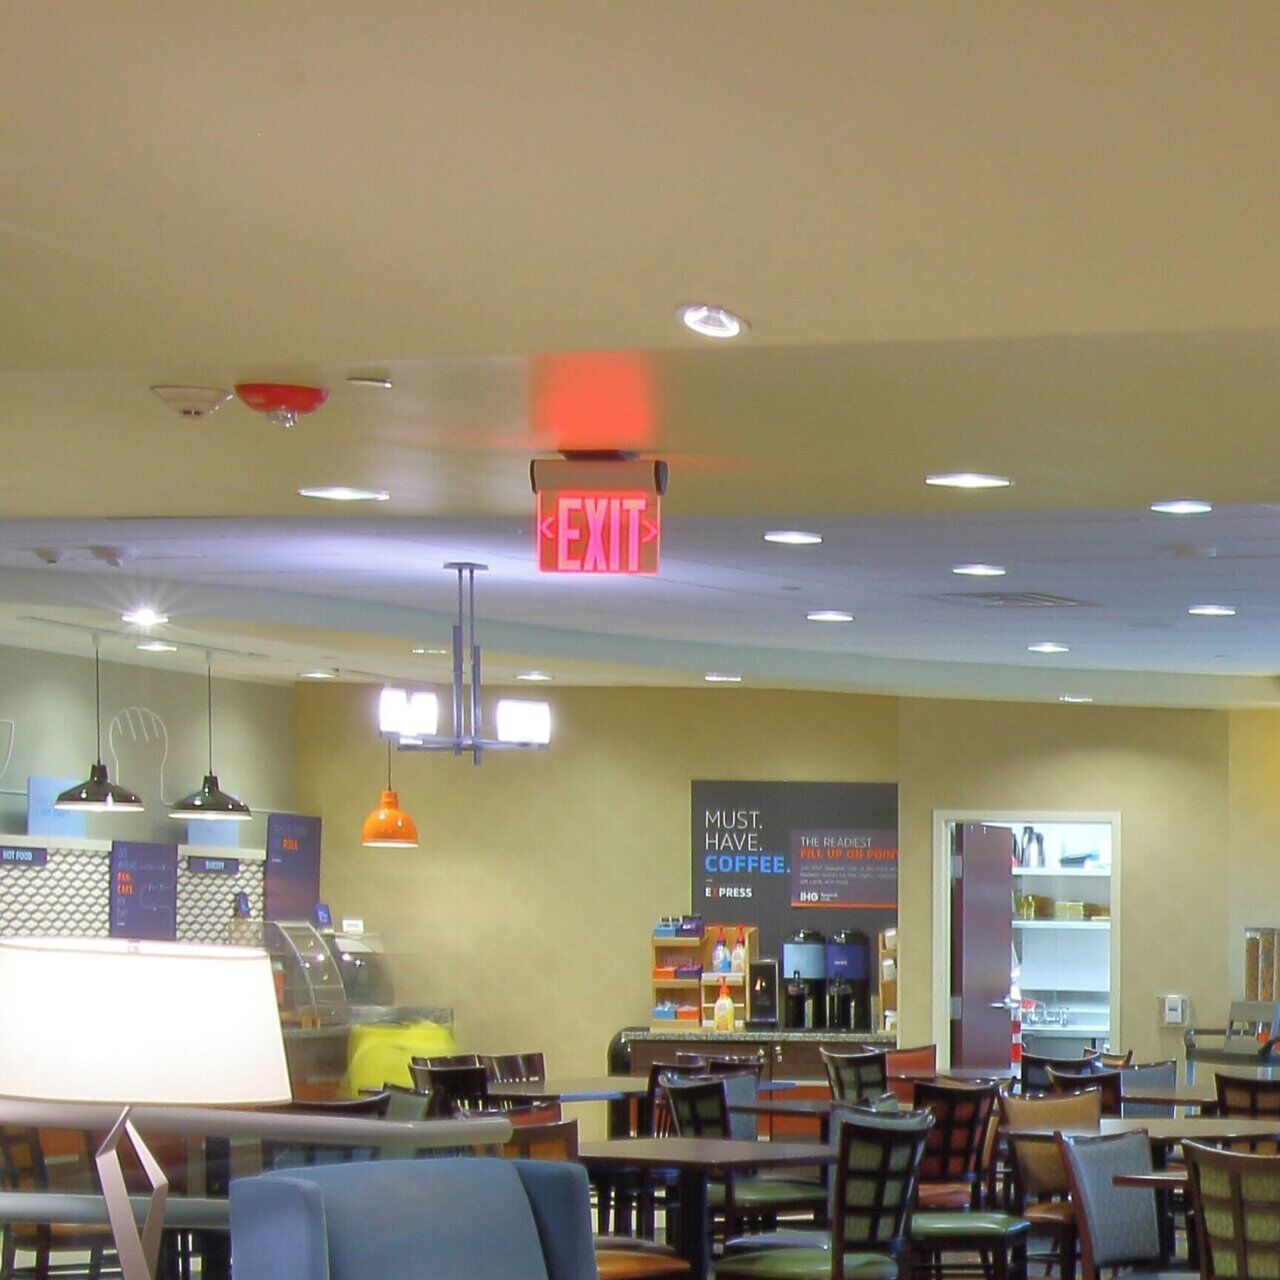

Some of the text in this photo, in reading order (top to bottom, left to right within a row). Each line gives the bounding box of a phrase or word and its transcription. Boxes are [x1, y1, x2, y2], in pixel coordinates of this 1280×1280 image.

[558, 498, 646, 571] EXIT
[705, 810, 763, 829] MUST.
[705, 833, 763, 851] HAVE.
[800, 836, 871, 849] THE READIEST
[827, 848, 841, 859] UP
[705, 855, 791, 874] COFFEE.
[705, 887, 752, 898] EXPRESS
